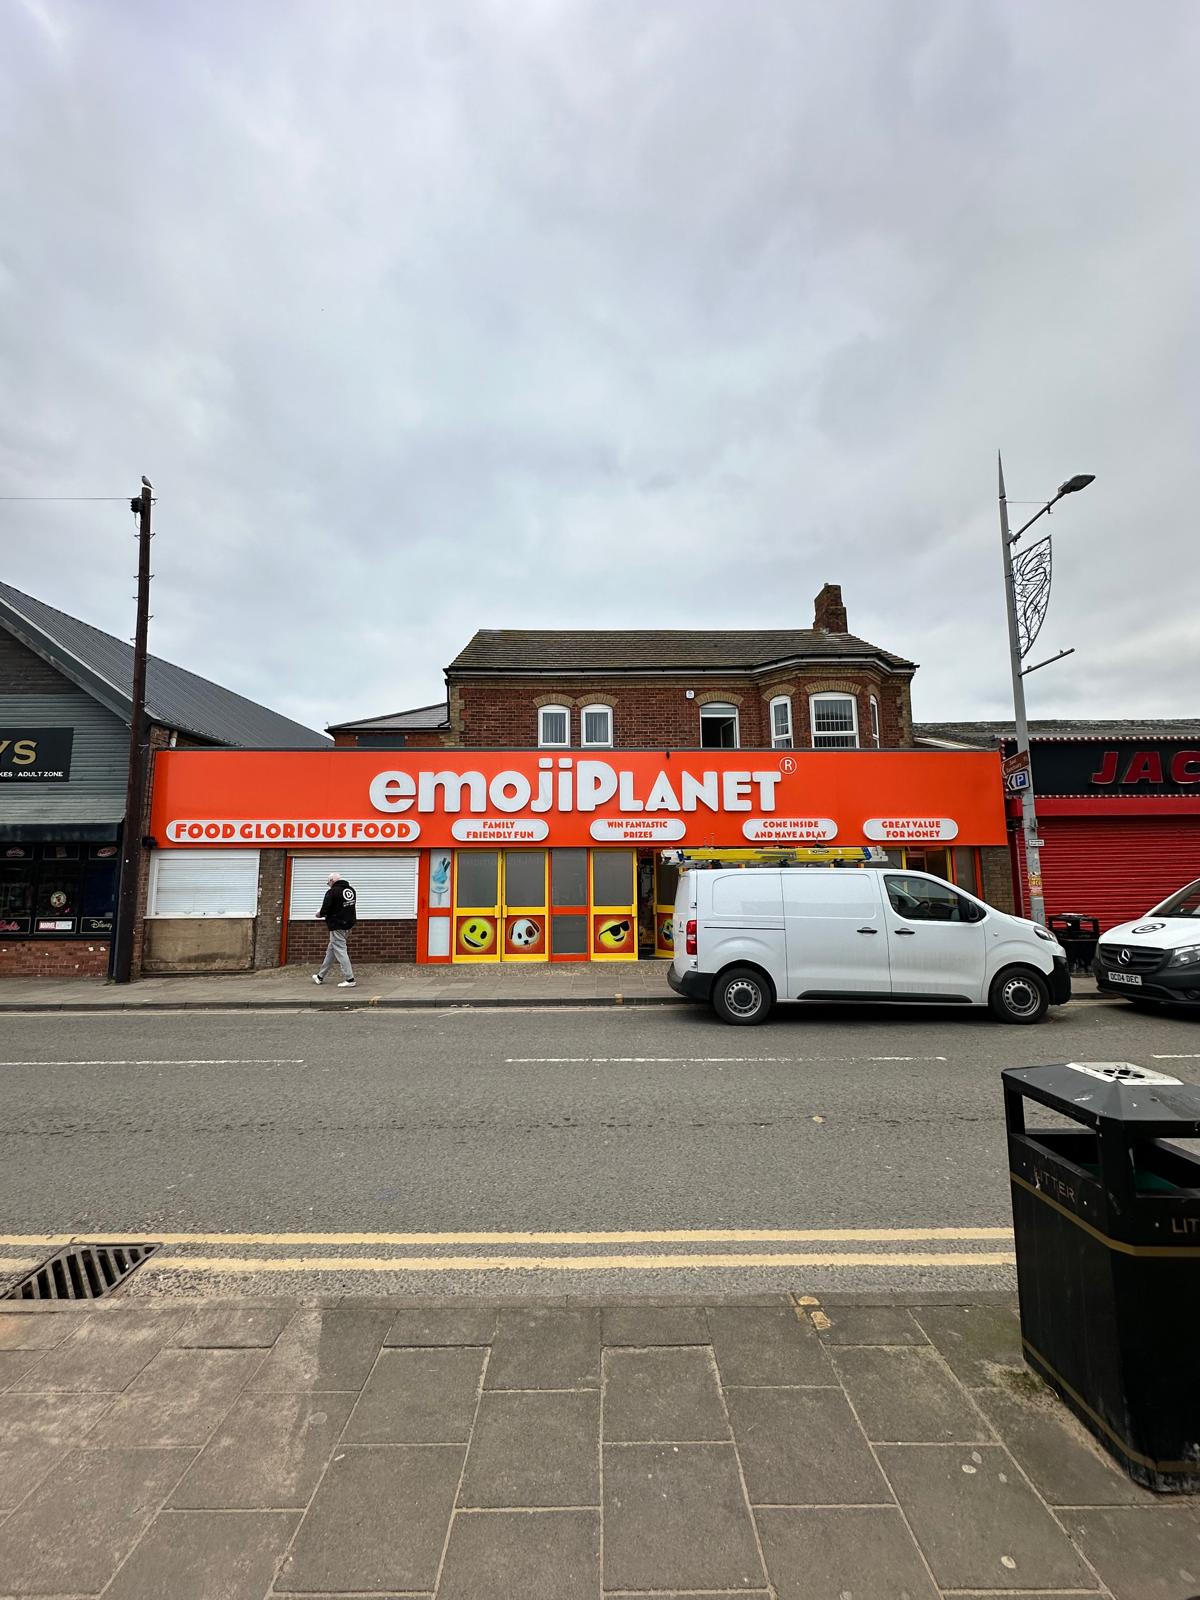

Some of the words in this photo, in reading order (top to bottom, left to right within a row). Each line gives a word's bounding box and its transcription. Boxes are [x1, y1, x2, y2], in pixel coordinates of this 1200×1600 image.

[1091, 750, 1200, 785] JAC
[1017, 774, 1024, 786] P
[482, 821, 516, 829] FAMILY
[607, 821, 624, 829] WIN
[625, 821, 668, 829] FANTASTIC
[762, 821, 788, 829] COME
[881, 821, 912, 829] GREAT
[175, 823, 236, 839] FOOD
[239, 823, 347, 839] GLORIOUS
[351, 822, 411, 839] FOOD
[886, 830, 907, 838] FOR
[907, 830, 941, 838] MONEY
[466, 831, 513, 839] FRIENDLY
[514, 831, 534, 839] FUN
[623, 831, 653, 839] PRIZES
[754, 831, 774, 839] AND
[774, 831, 798, 839] HAVE
[799, 831, 805, 839] A
[806, 831, 827, 839] PLAY
